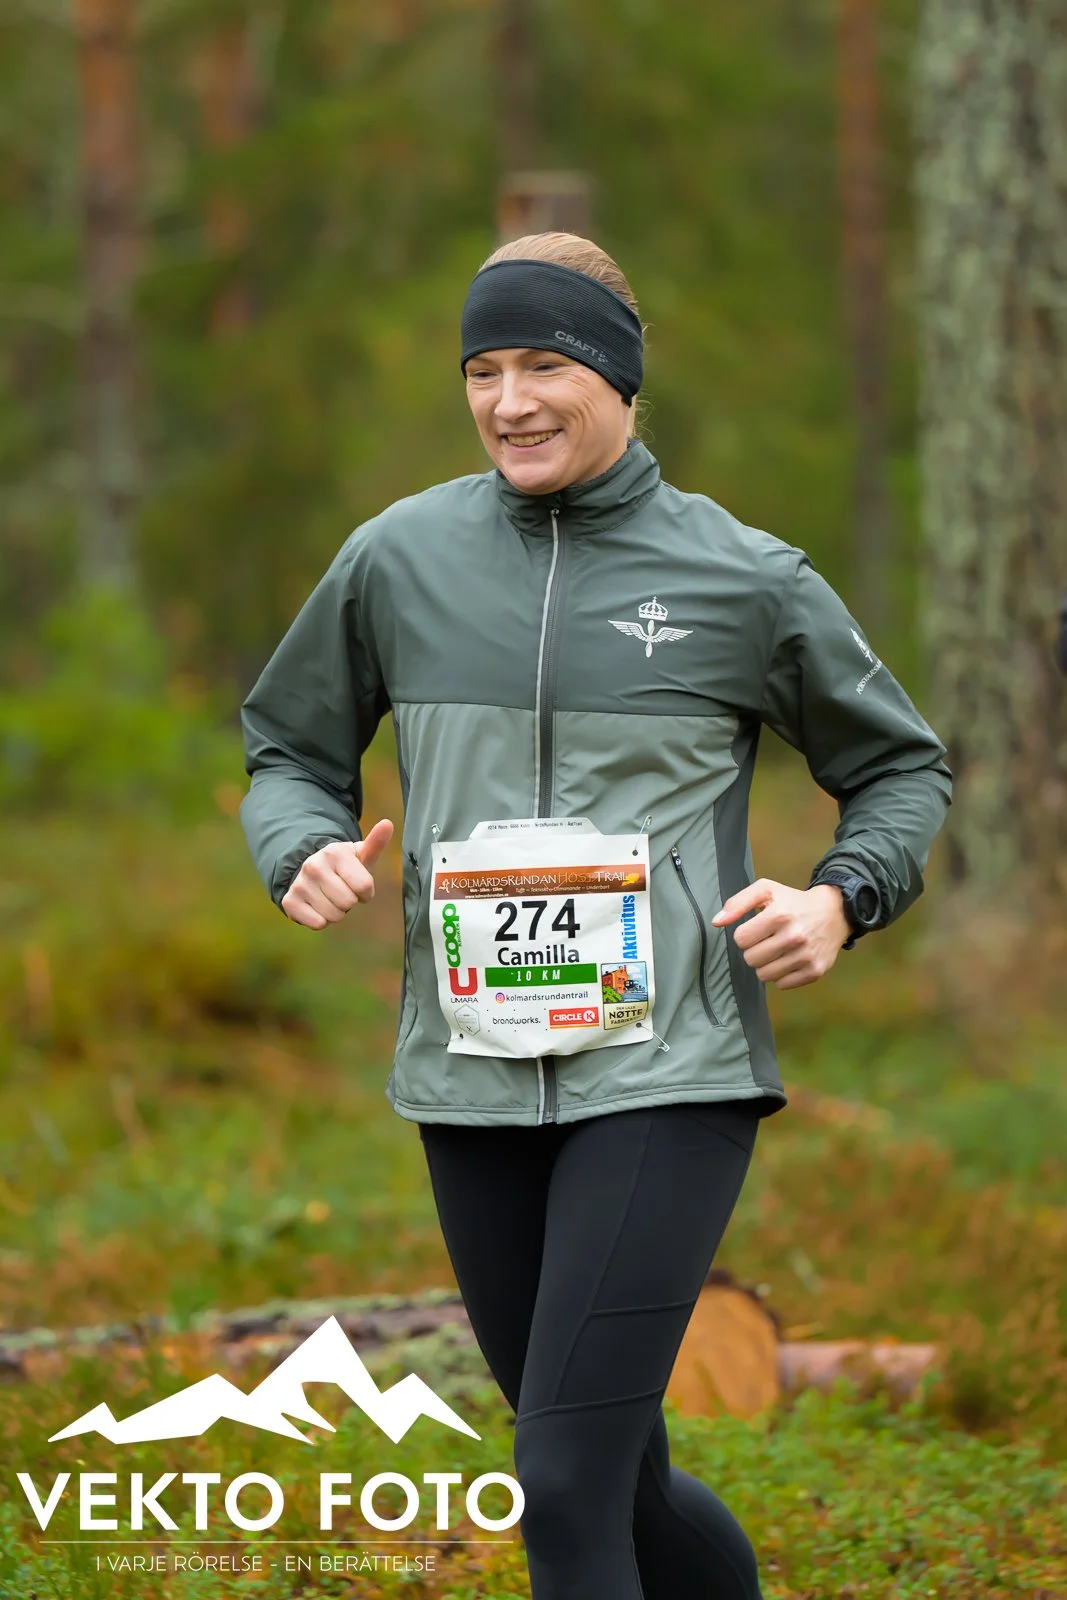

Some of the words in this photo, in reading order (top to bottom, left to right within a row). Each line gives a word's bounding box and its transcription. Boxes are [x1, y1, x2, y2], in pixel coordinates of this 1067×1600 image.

[554, 330, 598, 357] CRAFT
[494, 898, 581, 942] 274
[621, 894, 638, 960] Aktivitus
[442, 903, 461, 968] coop
[497, 944, 580, 966] Camilla
[516, 970, 532, 982] 10
[542, 969, 561, 981] KM
[506, 991, 589, 1002] kolmardsrundantrail
[552, 1013, 582, 1022] CIRCLE
